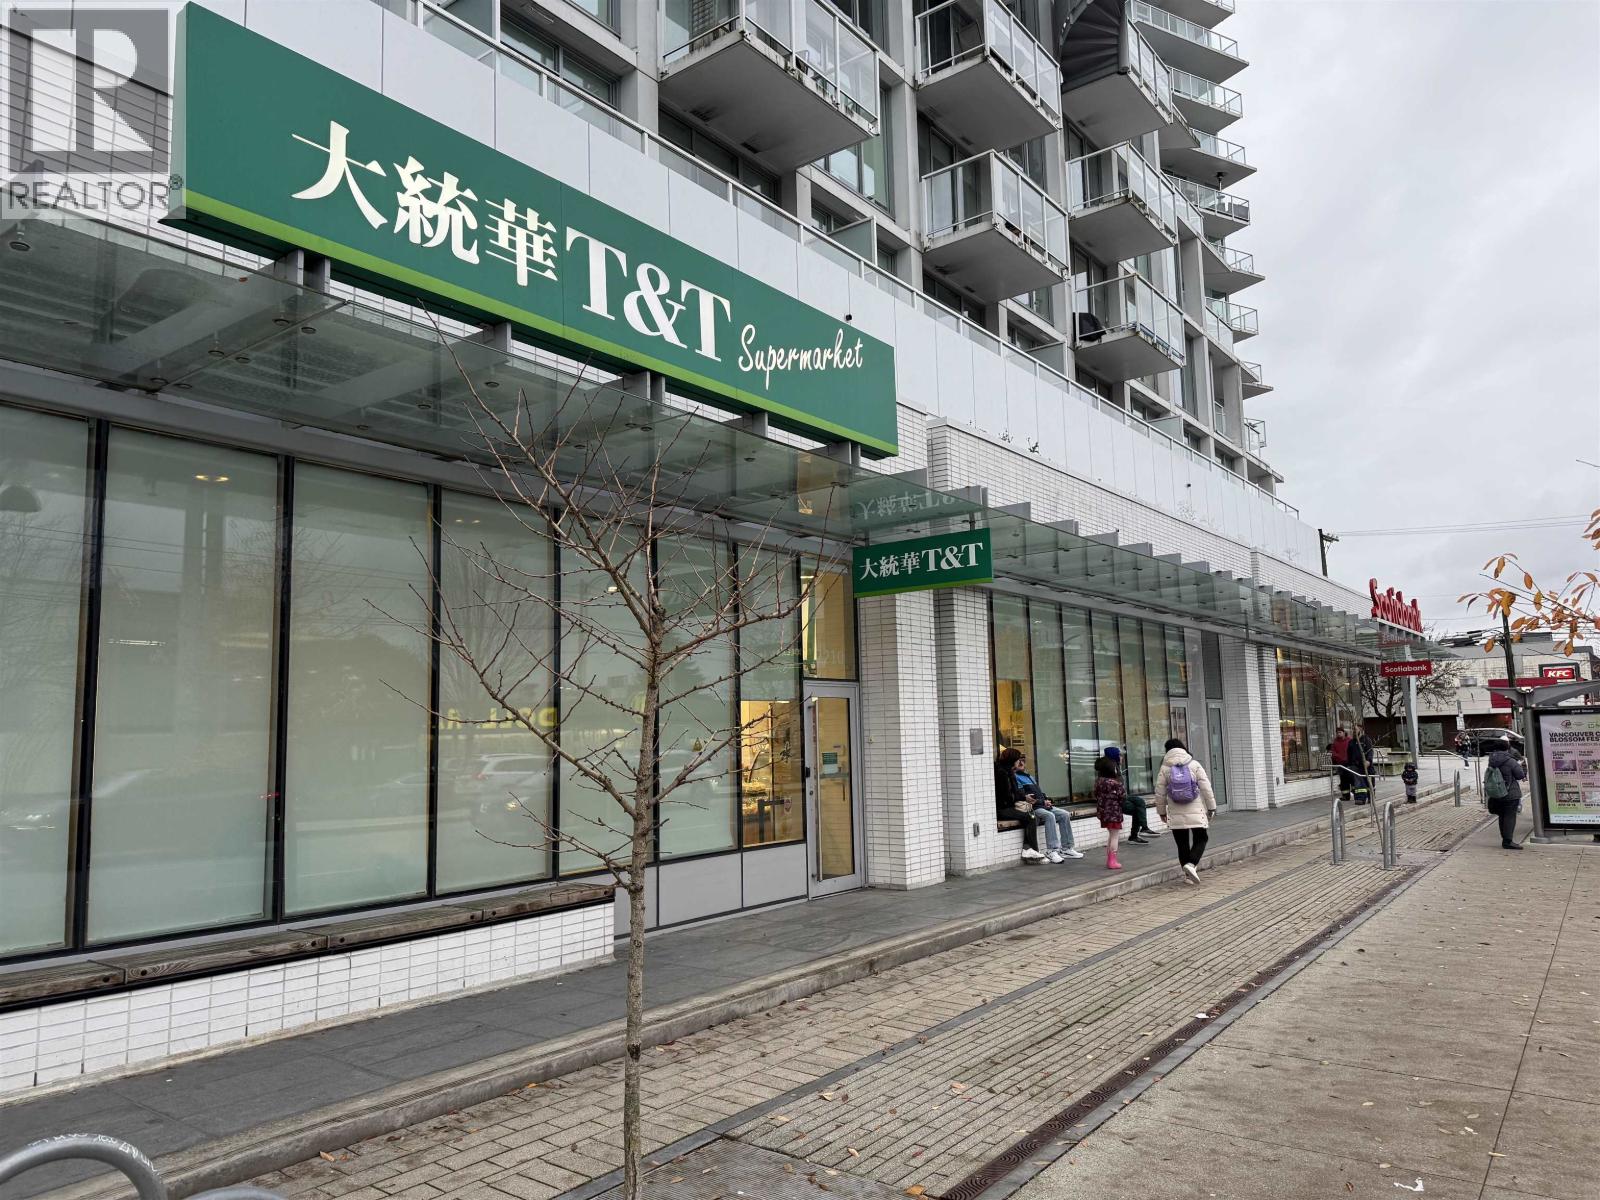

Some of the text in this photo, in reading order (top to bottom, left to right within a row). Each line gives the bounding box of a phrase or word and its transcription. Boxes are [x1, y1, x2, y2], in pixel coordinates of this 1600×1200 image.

[292, 120, 864, 390] 大統華 T&T Supermarket
[859, 542, 984, 581] 大統華 T&T
[1384, 664, 1428, 673] Scotiabank
[1547, 669, 1572, 678] KFC
